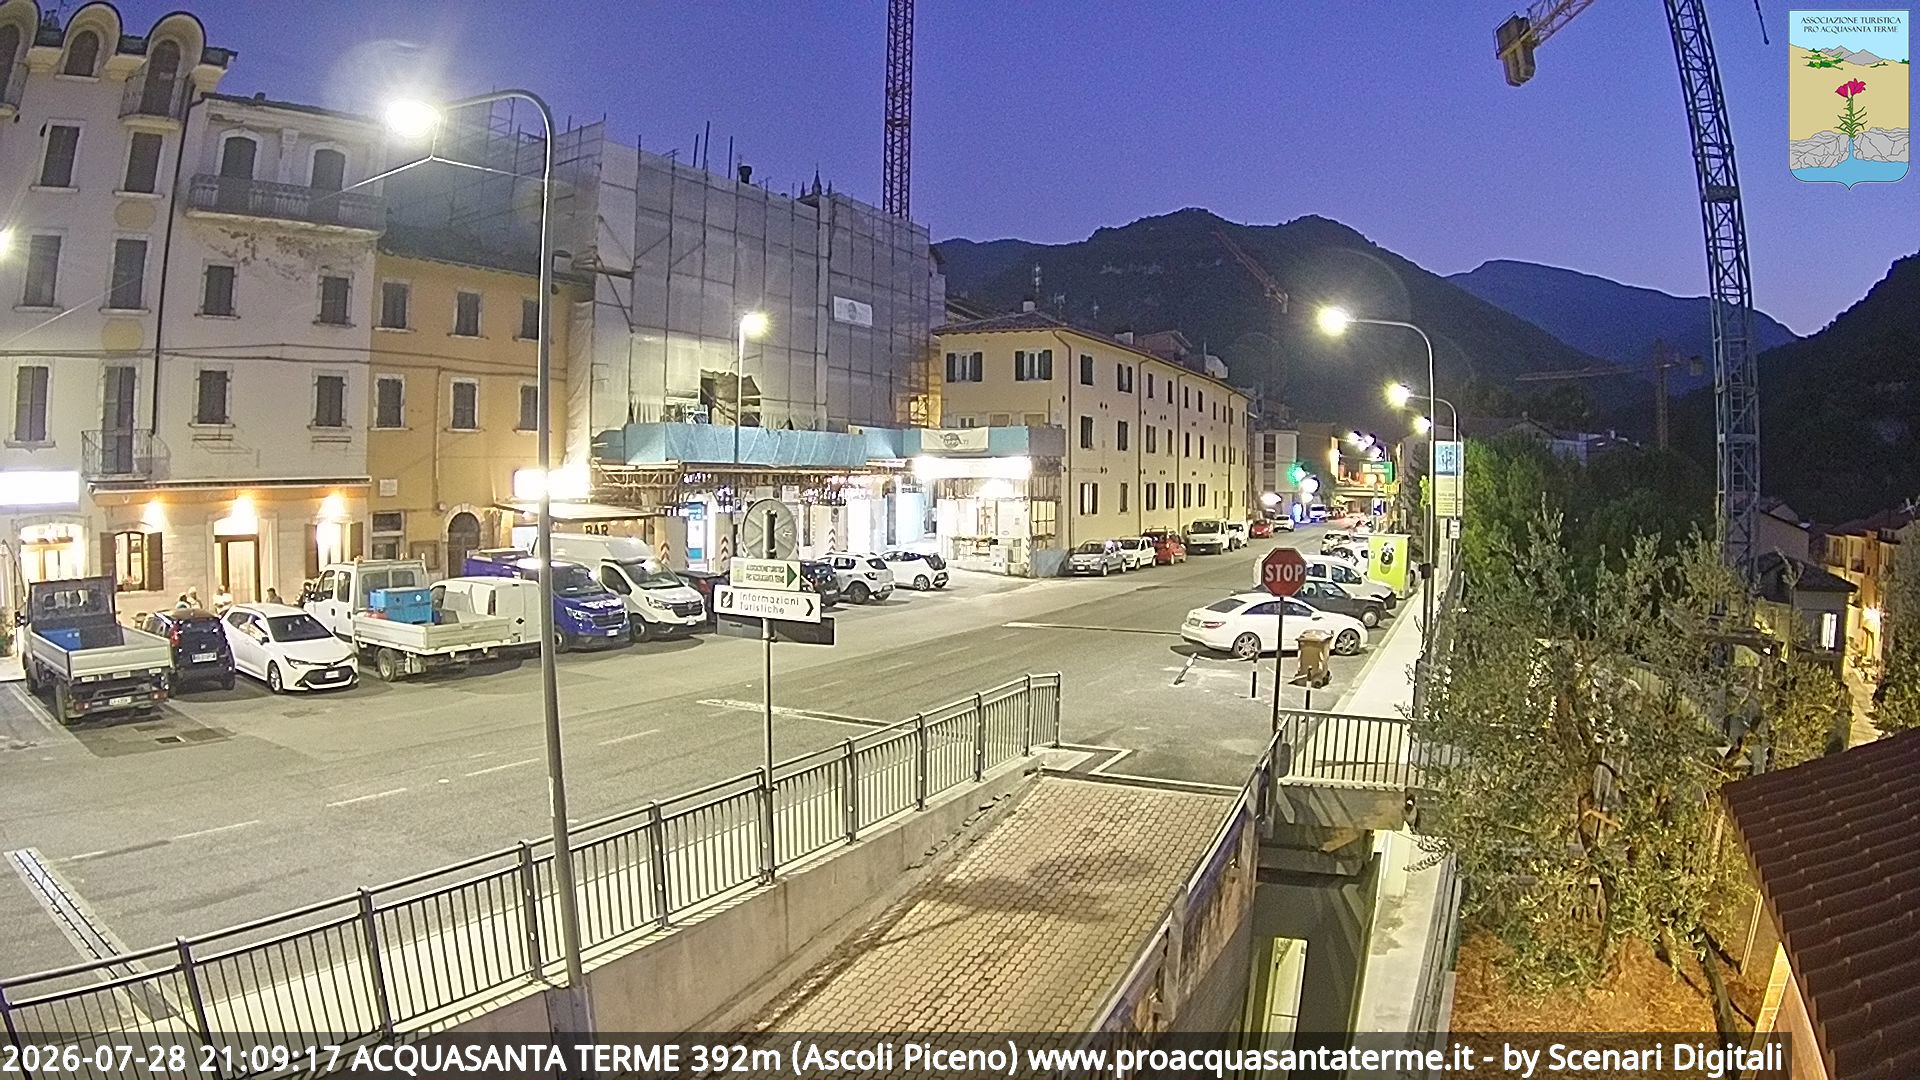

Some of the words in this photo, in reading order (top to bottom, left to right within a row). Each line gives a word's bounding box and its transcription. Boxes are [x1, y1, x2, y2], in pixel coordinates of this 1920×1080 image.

[584, 524, 609, 536] BAR
[1265, 564, 1304, 582] STOP
[740, 592, 799, 606] Informazioni
[740, 602, 785, 615] Turistiche
